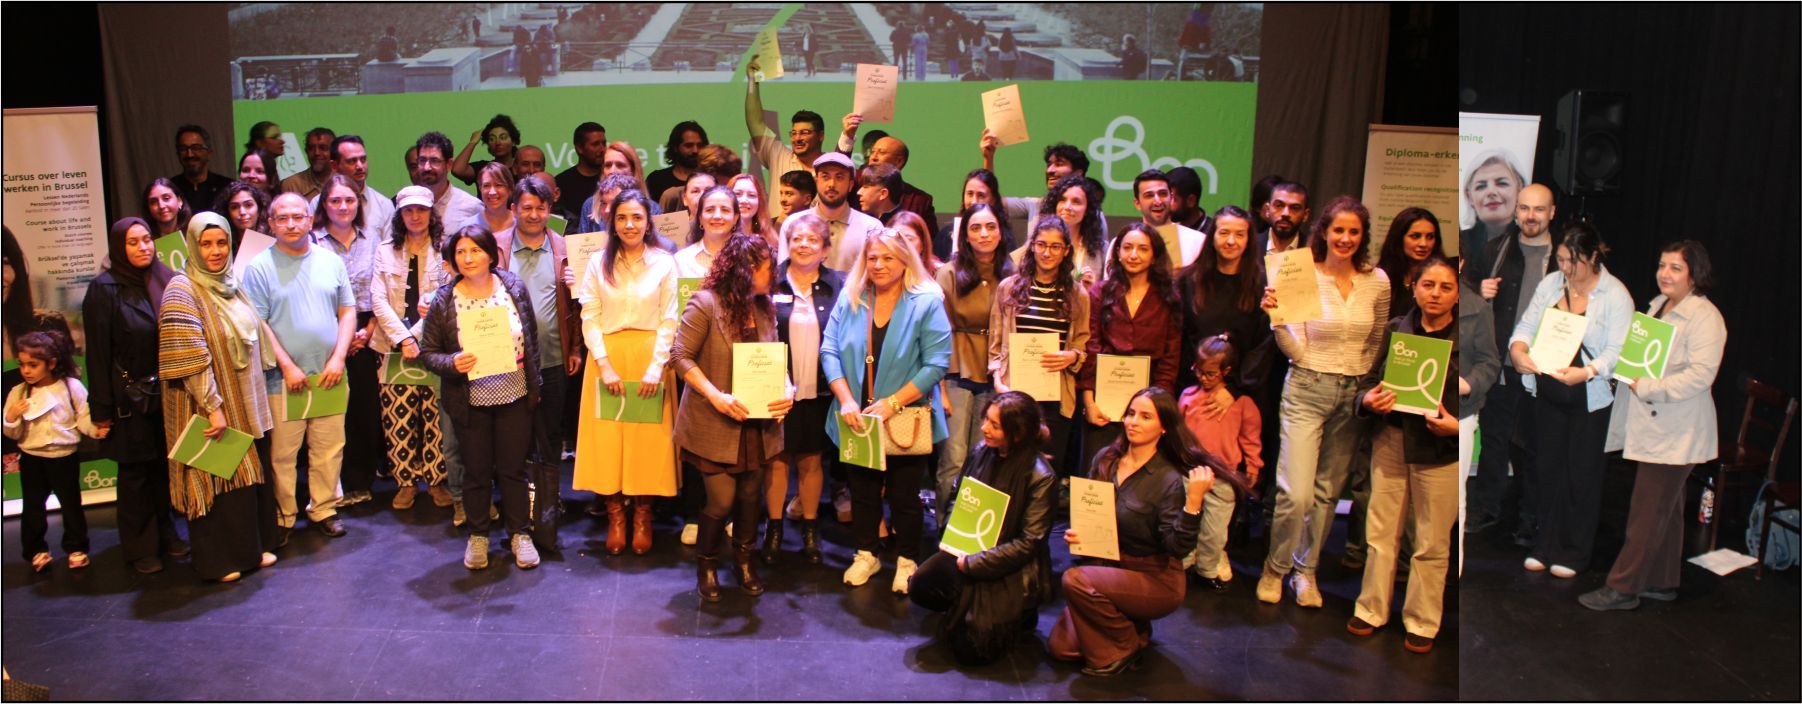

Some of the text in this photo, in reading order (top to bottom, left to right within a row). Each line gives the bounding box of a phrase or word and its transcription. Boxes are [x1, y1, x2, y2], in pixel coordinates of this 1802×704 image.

[1385, 148, 1459, 160] Diploma-erke
[3, 170, 87, 182] Cursus over leven
[3, 181, 88, 193] werken in Brussel
